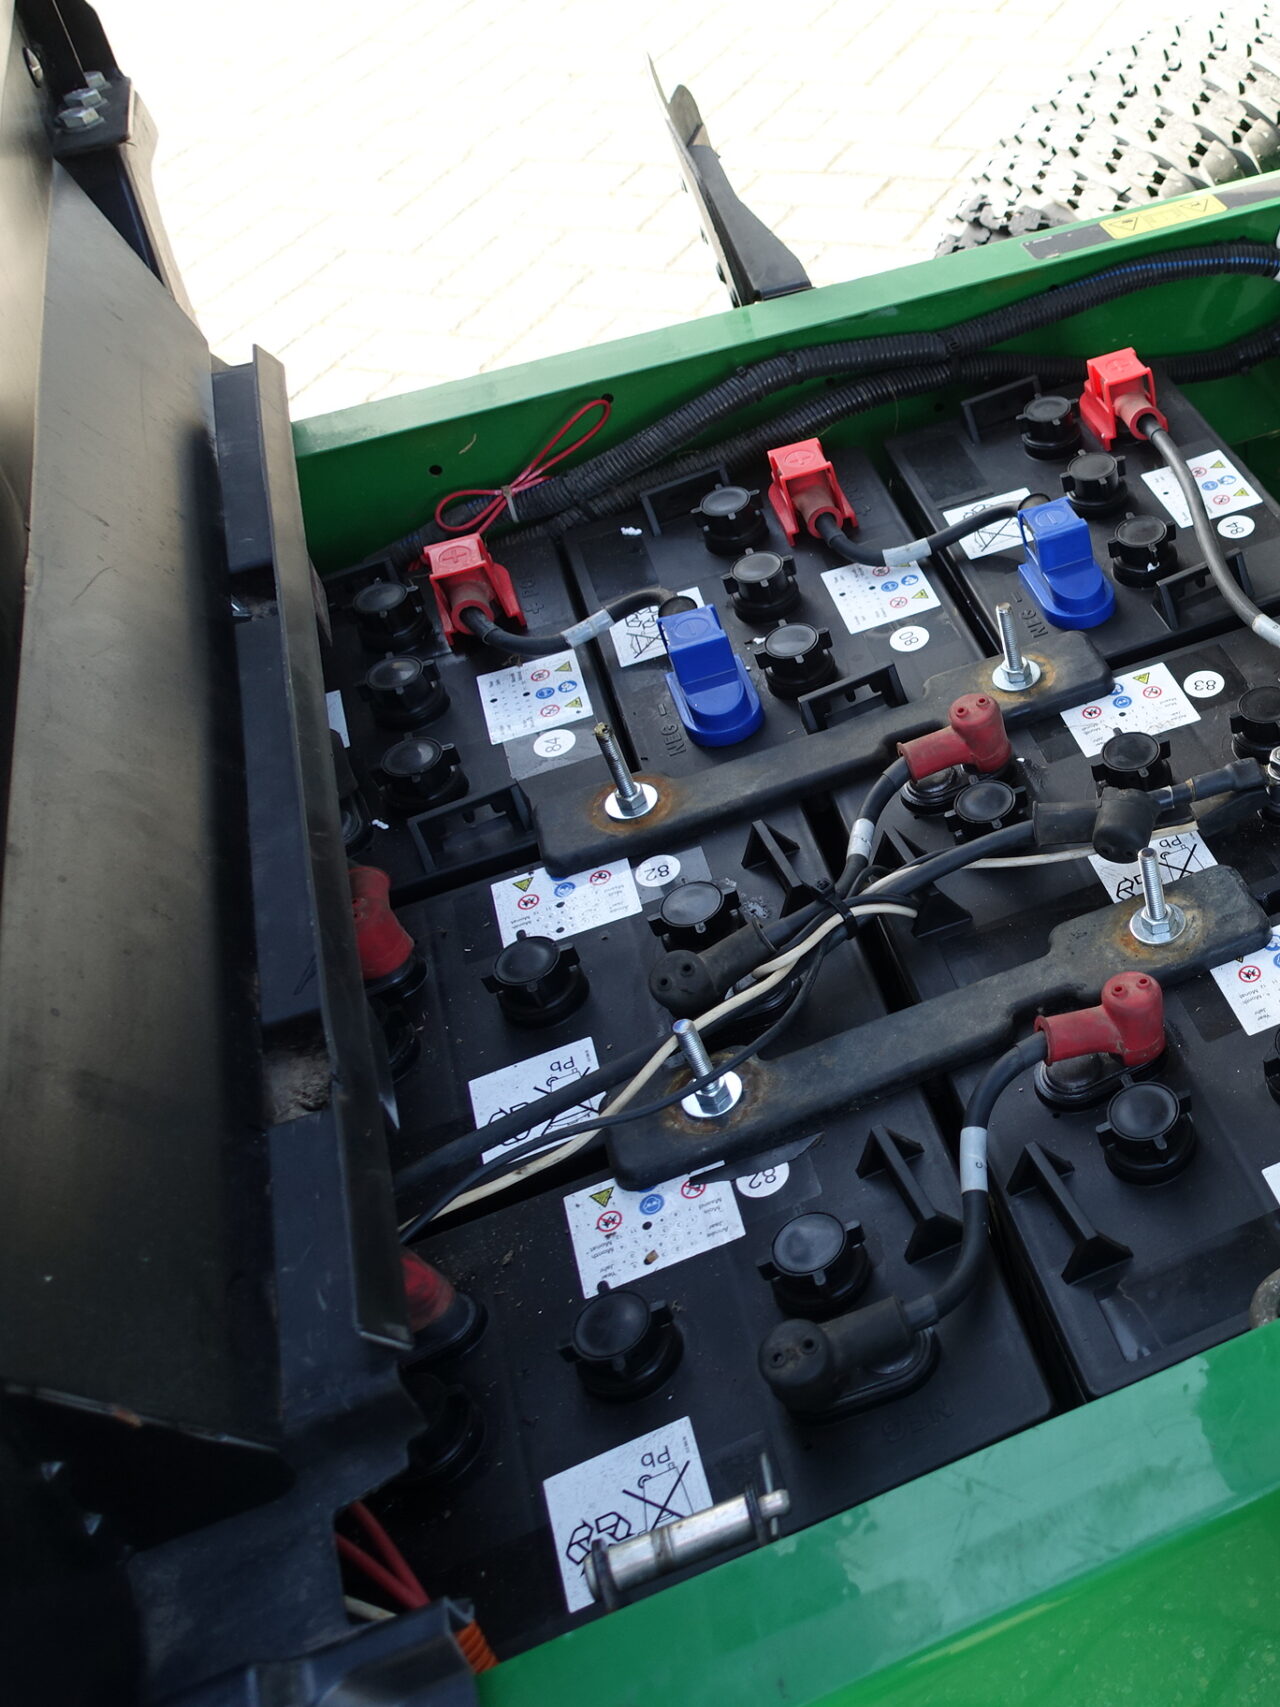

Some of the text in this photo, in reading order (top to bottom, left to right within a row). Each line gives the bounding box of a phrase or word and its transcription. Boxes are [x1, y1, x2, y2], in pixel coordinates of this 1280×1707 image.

[1226, 521, 1245, 535] 84
[898, 630, 919, 646] 80
[1193, 678, 1216, 691] 83
[544, 736, 562, 753] 84
[660, 724, 687, 757] NEG
[1159, 835, 1182, 848] Pb
[643, 864, 670, 882] 82
[549, 1056, 575, 1072] Pb
[748, 1167, 776, 1189] 82
[641, 1445, 672, 1468] Pb
